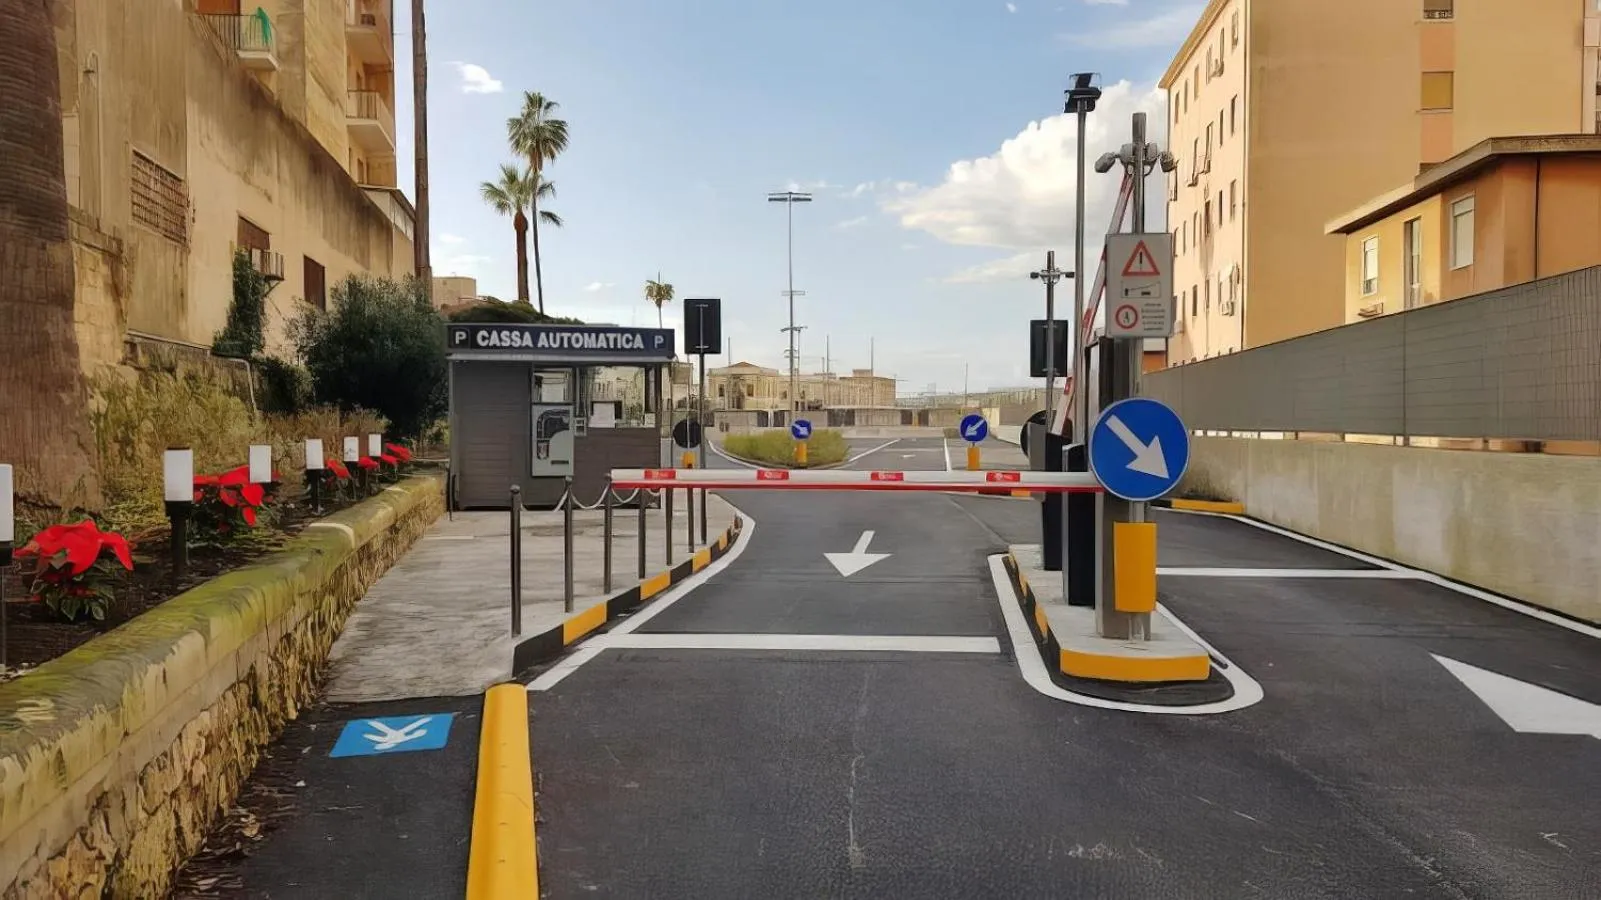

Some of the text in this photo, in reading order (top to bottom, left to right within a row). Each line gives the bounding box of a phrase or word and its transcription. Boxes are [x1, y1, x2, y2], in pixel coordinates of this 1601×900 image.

[455, 330, 664, 349] P CASSA AUTOMATICA P
